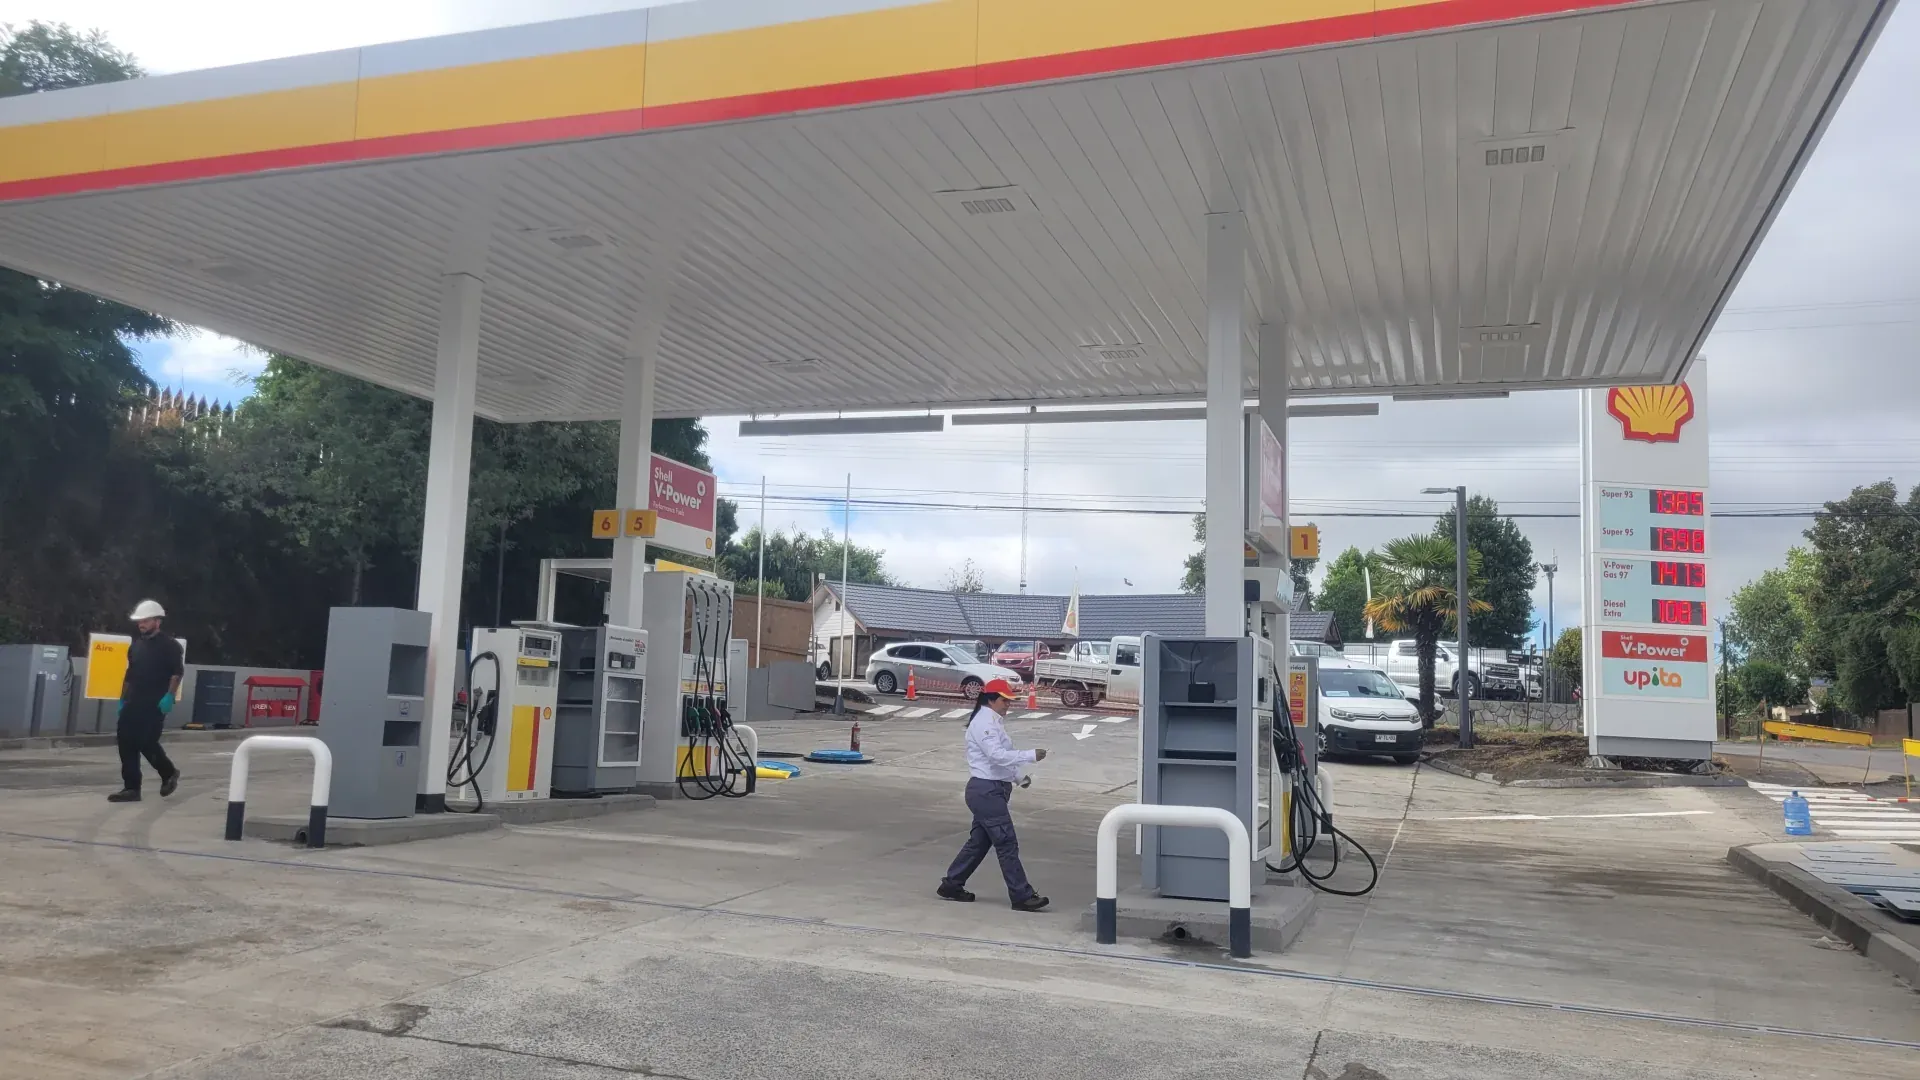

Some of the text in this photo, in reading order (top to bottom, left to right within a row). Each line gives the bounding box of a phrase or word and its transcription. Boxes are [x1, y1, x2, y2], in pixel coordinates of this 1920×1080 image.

[654, 466, 673, 483] Shell
[654, 480, 702, 509] V-Power
[1602, 489, 1633, 498] Super 93
[1656, 488, 1703, 515] 1385
[601, 516, 611, 531] 6
[633, 517, 643, 531] 5
[1602, 527, 1634, 537] Super 95
[1301, 534, 1309, 550] 1
[1657, 527, 1704, 553] 1398
[1603, 561, 1634, 570] V-Power
[1603, 570, 1629, 579] Gas 97
[1656, 561, 1705, 587] 1413
[1603, 599, 1626, 608] Diesel
[1603, 609, 1622, 617] Extra
[1658, 599, 1706, 626] 1081
[95, 643, 114, 652] Aire
[1620, 640, 1687, 657] V-Power
[1623, 666, 1682, 690] upita
